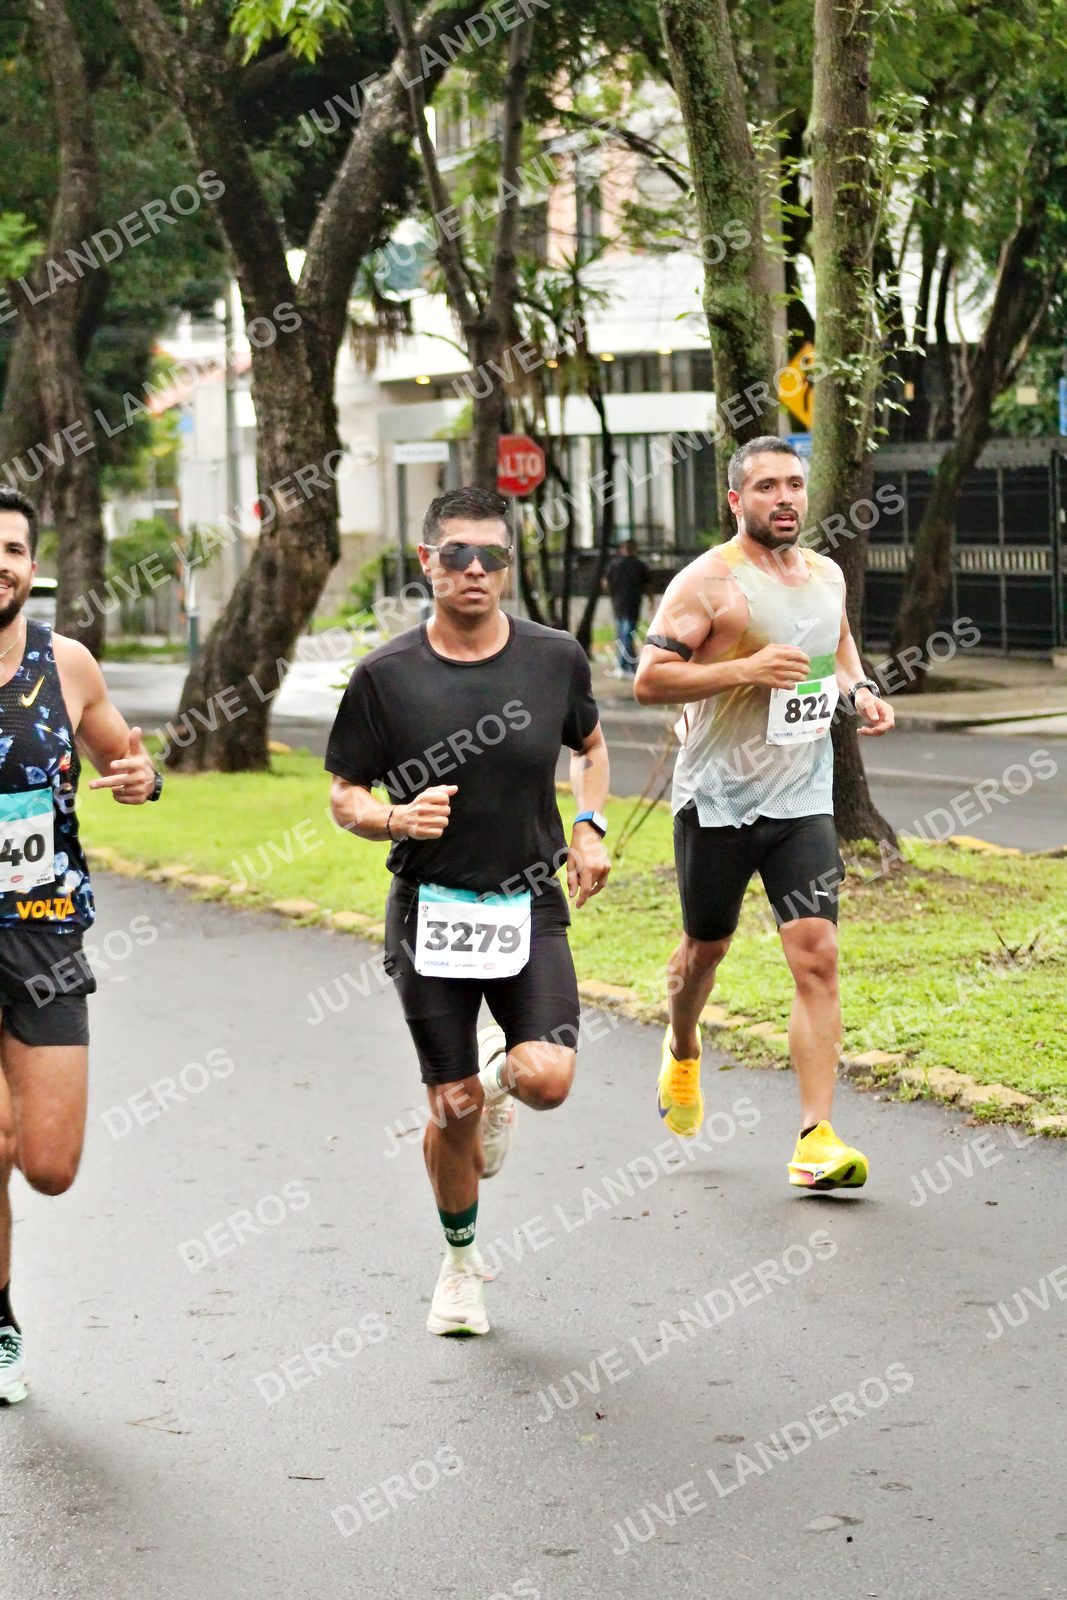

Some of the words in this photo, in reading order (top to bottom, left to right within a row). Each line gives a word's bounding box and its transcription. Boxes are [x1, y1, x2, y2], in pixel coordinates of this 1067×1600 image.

[785, 693, 830, 723] 822
[16, 896, 75, 920] VOLTA
[425, 921, 521, 954] 3279
